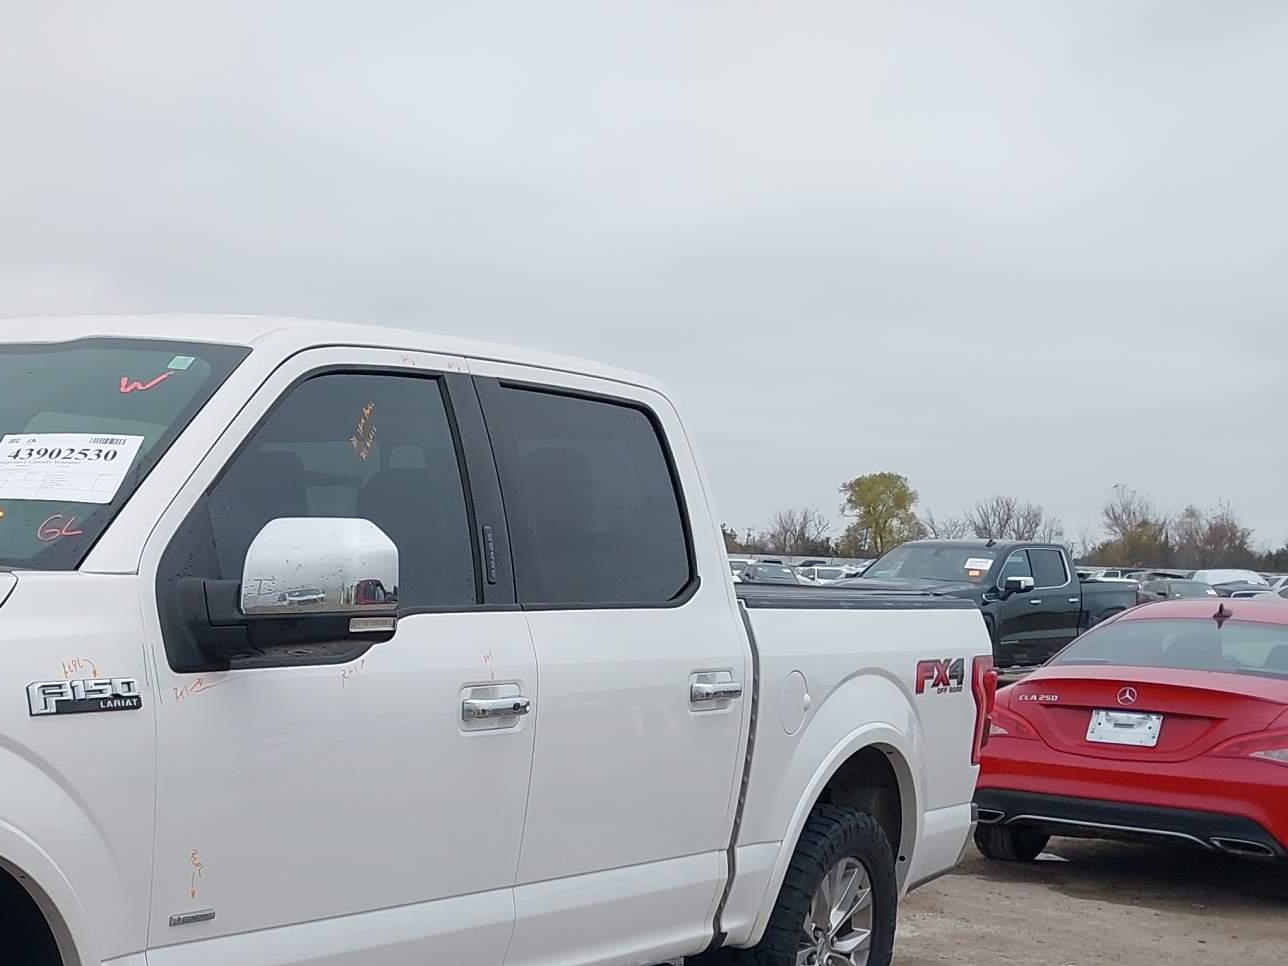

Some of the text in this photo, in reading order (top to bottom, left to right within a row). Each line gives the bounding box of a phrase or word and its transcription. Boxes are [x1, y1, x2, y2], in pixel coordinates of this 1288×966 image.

[7, 447, 118, 462] 43902530
[915, 658, 965, 694] FX4
[99, 699, 138, 709] LARIAT
[1038, 694, 1059, 702] 250
